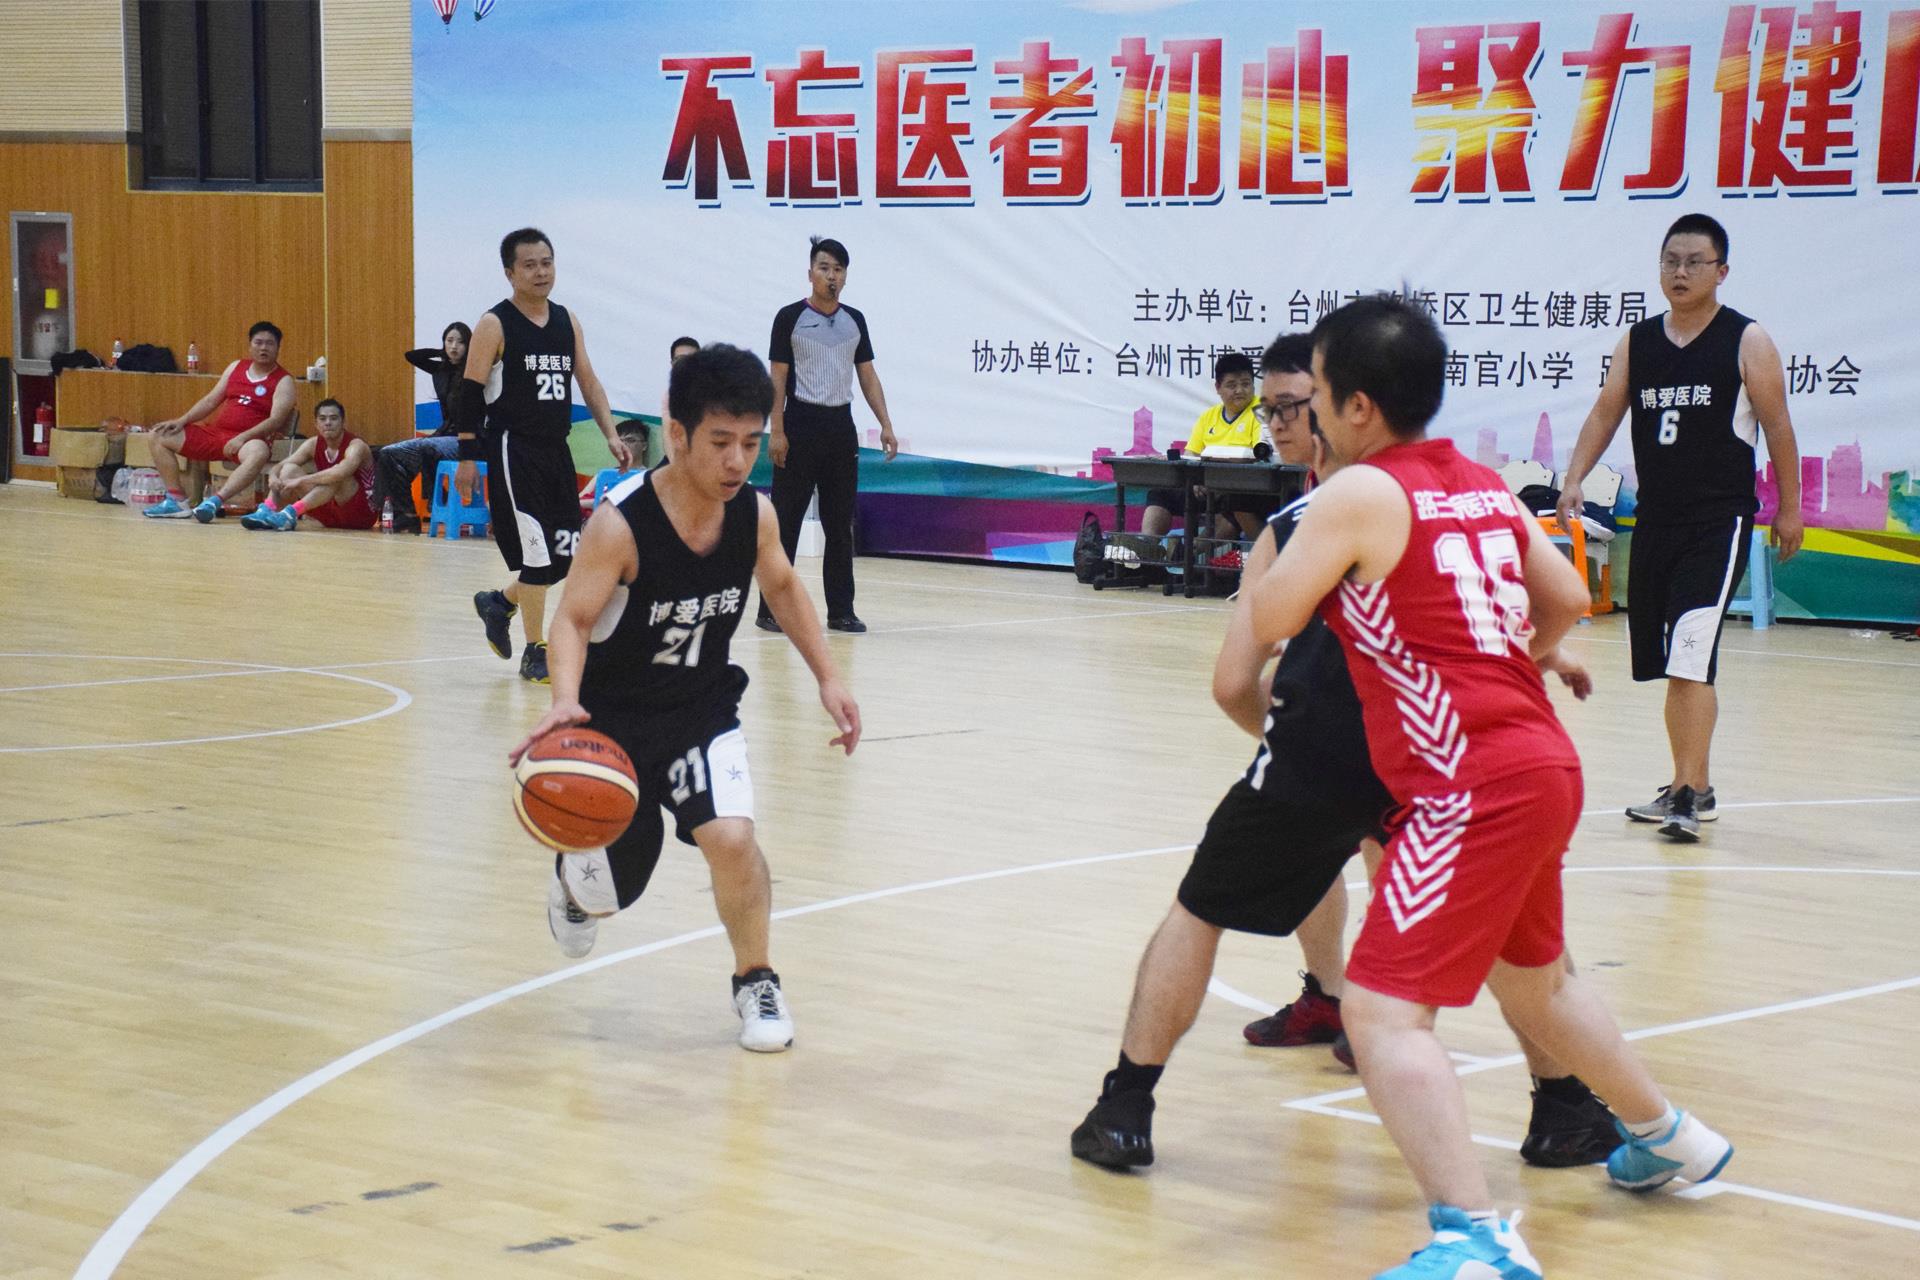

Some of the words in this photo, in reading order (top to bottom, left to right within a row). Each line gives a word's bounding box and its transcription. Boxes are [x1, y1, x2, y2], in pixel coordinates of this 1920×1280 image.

[661, 28, 1351, 208] 不忘医者初心
[523, 354, 572, 371] 博爱医院
[536, 373, 566, 401] 26
[1640, 384, 1712, 409] 博爱医院
[1658, 409, 1680, 445] 6
[648, 586, 741, 627] 博爱医院
[651, 621, 708, 667] 21
[667, 746, 707, 806] 21
